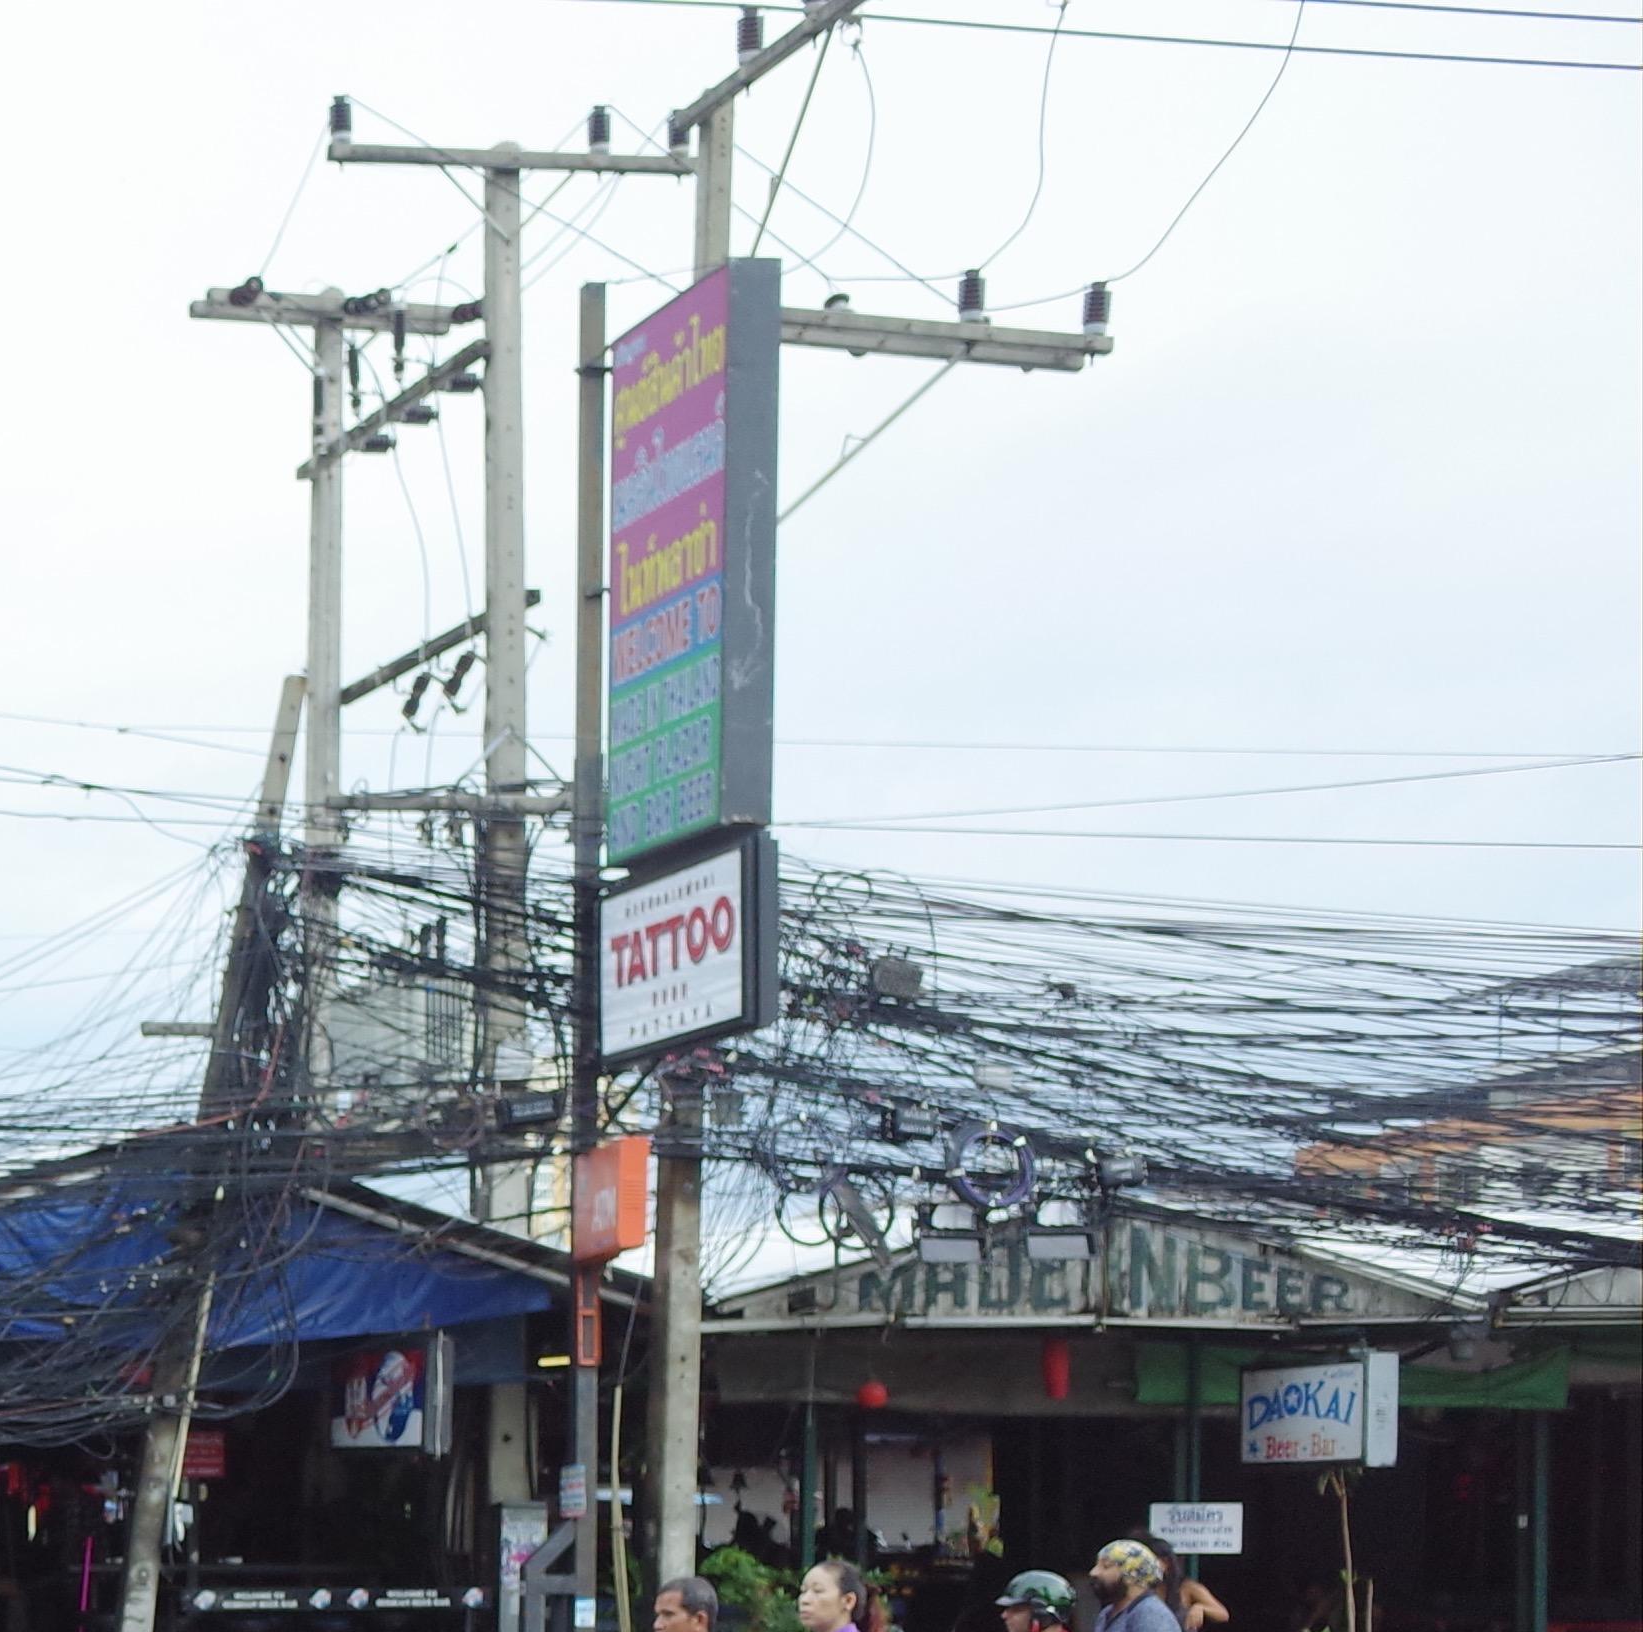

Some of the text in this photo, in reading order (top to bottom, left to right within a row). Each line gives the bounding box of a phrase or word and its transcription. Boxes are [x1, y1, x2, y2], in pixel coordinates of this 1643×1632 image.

[696, 580, 724, 644] TO
[611, 895, 735, 989] TATTOO
[1248, 1379, 1358, 1431] DAOKAI
